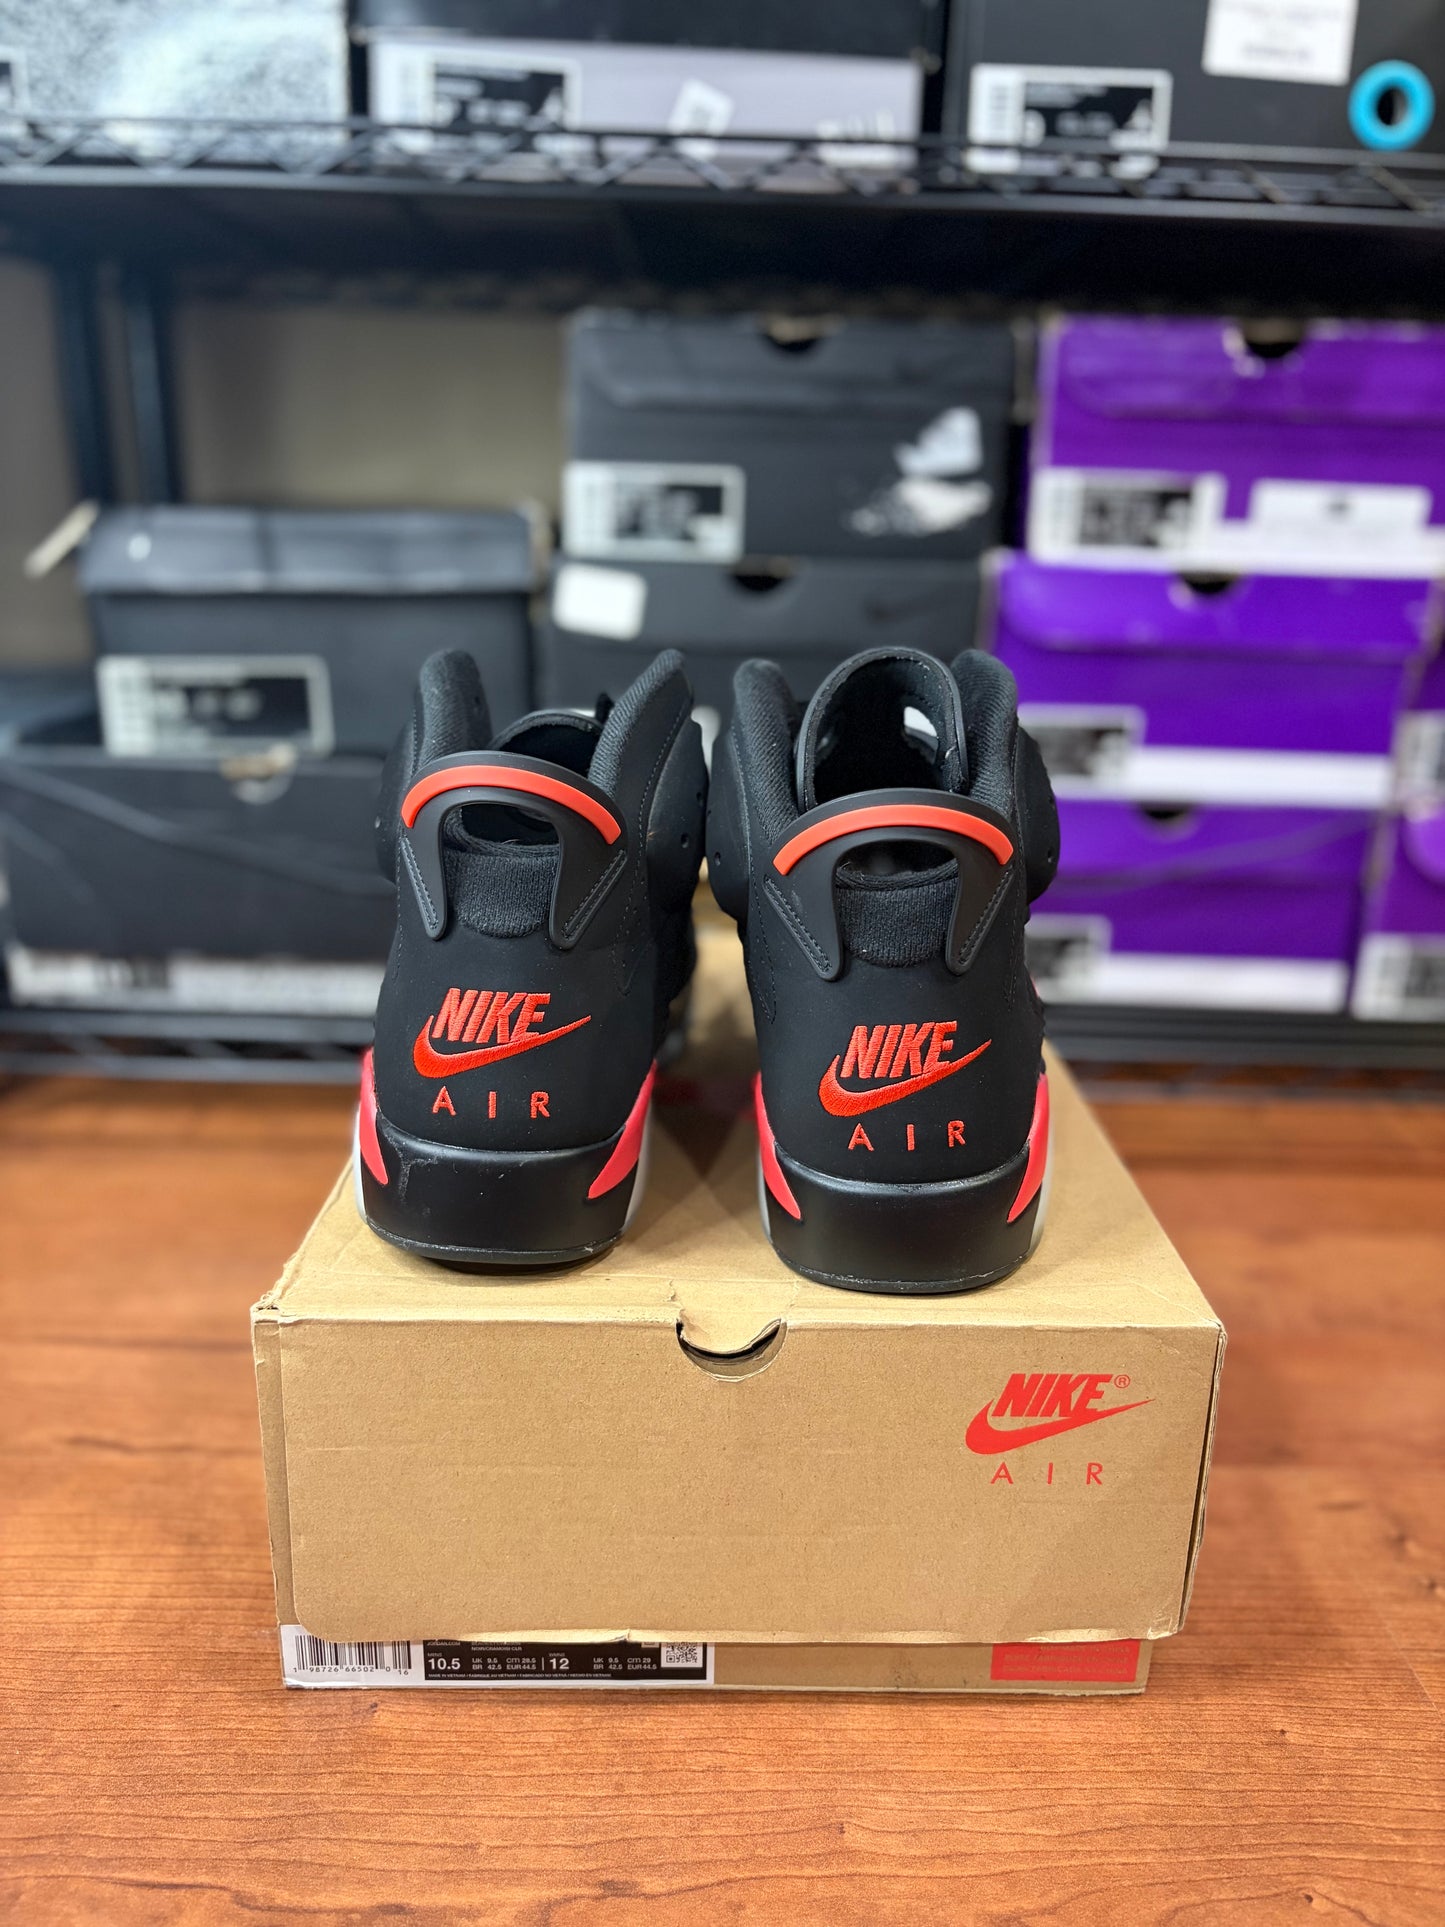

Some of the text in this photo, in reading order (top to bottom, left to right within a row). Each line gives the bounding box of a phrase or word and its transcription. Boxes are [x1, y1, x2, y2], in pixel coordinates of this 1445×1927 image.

[432, 987, 550, 1044] NIKE
[840, 1020, 957, 1075] NIKE
[432, 1085, 550, 1119] AIR
[848, 1120, 966, 1151] AIR
[990, 1461, 1103, 1485] AIR
[428, 1658, 461, 1670] 10.5
[549, 1658, 569, 1670] 12
